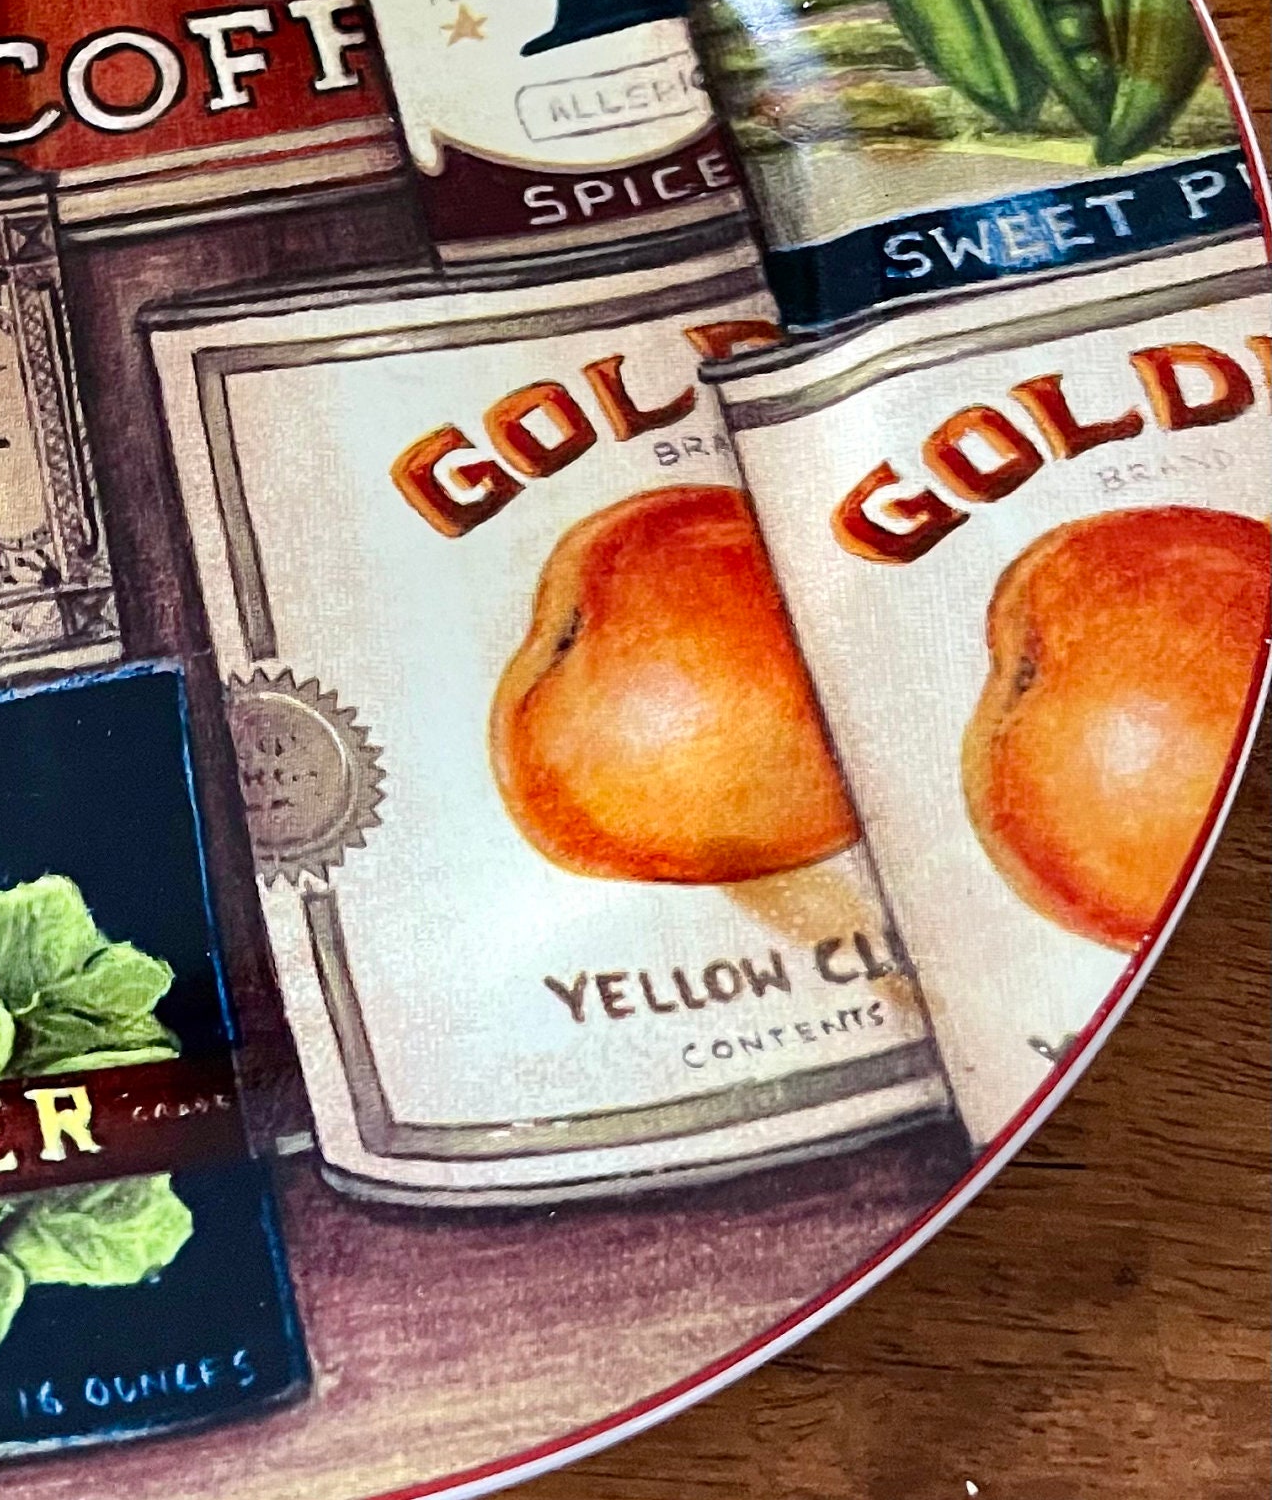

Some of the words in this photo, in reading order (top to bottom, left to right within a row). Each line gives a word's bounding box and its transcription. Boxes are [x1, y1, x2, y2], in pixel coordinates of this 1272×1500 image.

[523, 151, 731, 226] SPICE
[883, 190, 1137, 280] SWEET
[542, 947, 793, 1024] YELLOW
[681, 1001, 885, 1069] CONTENTS
[17, 1379, 64, 1418] 16
[84, 1348, 256, 1407] OUNCES
